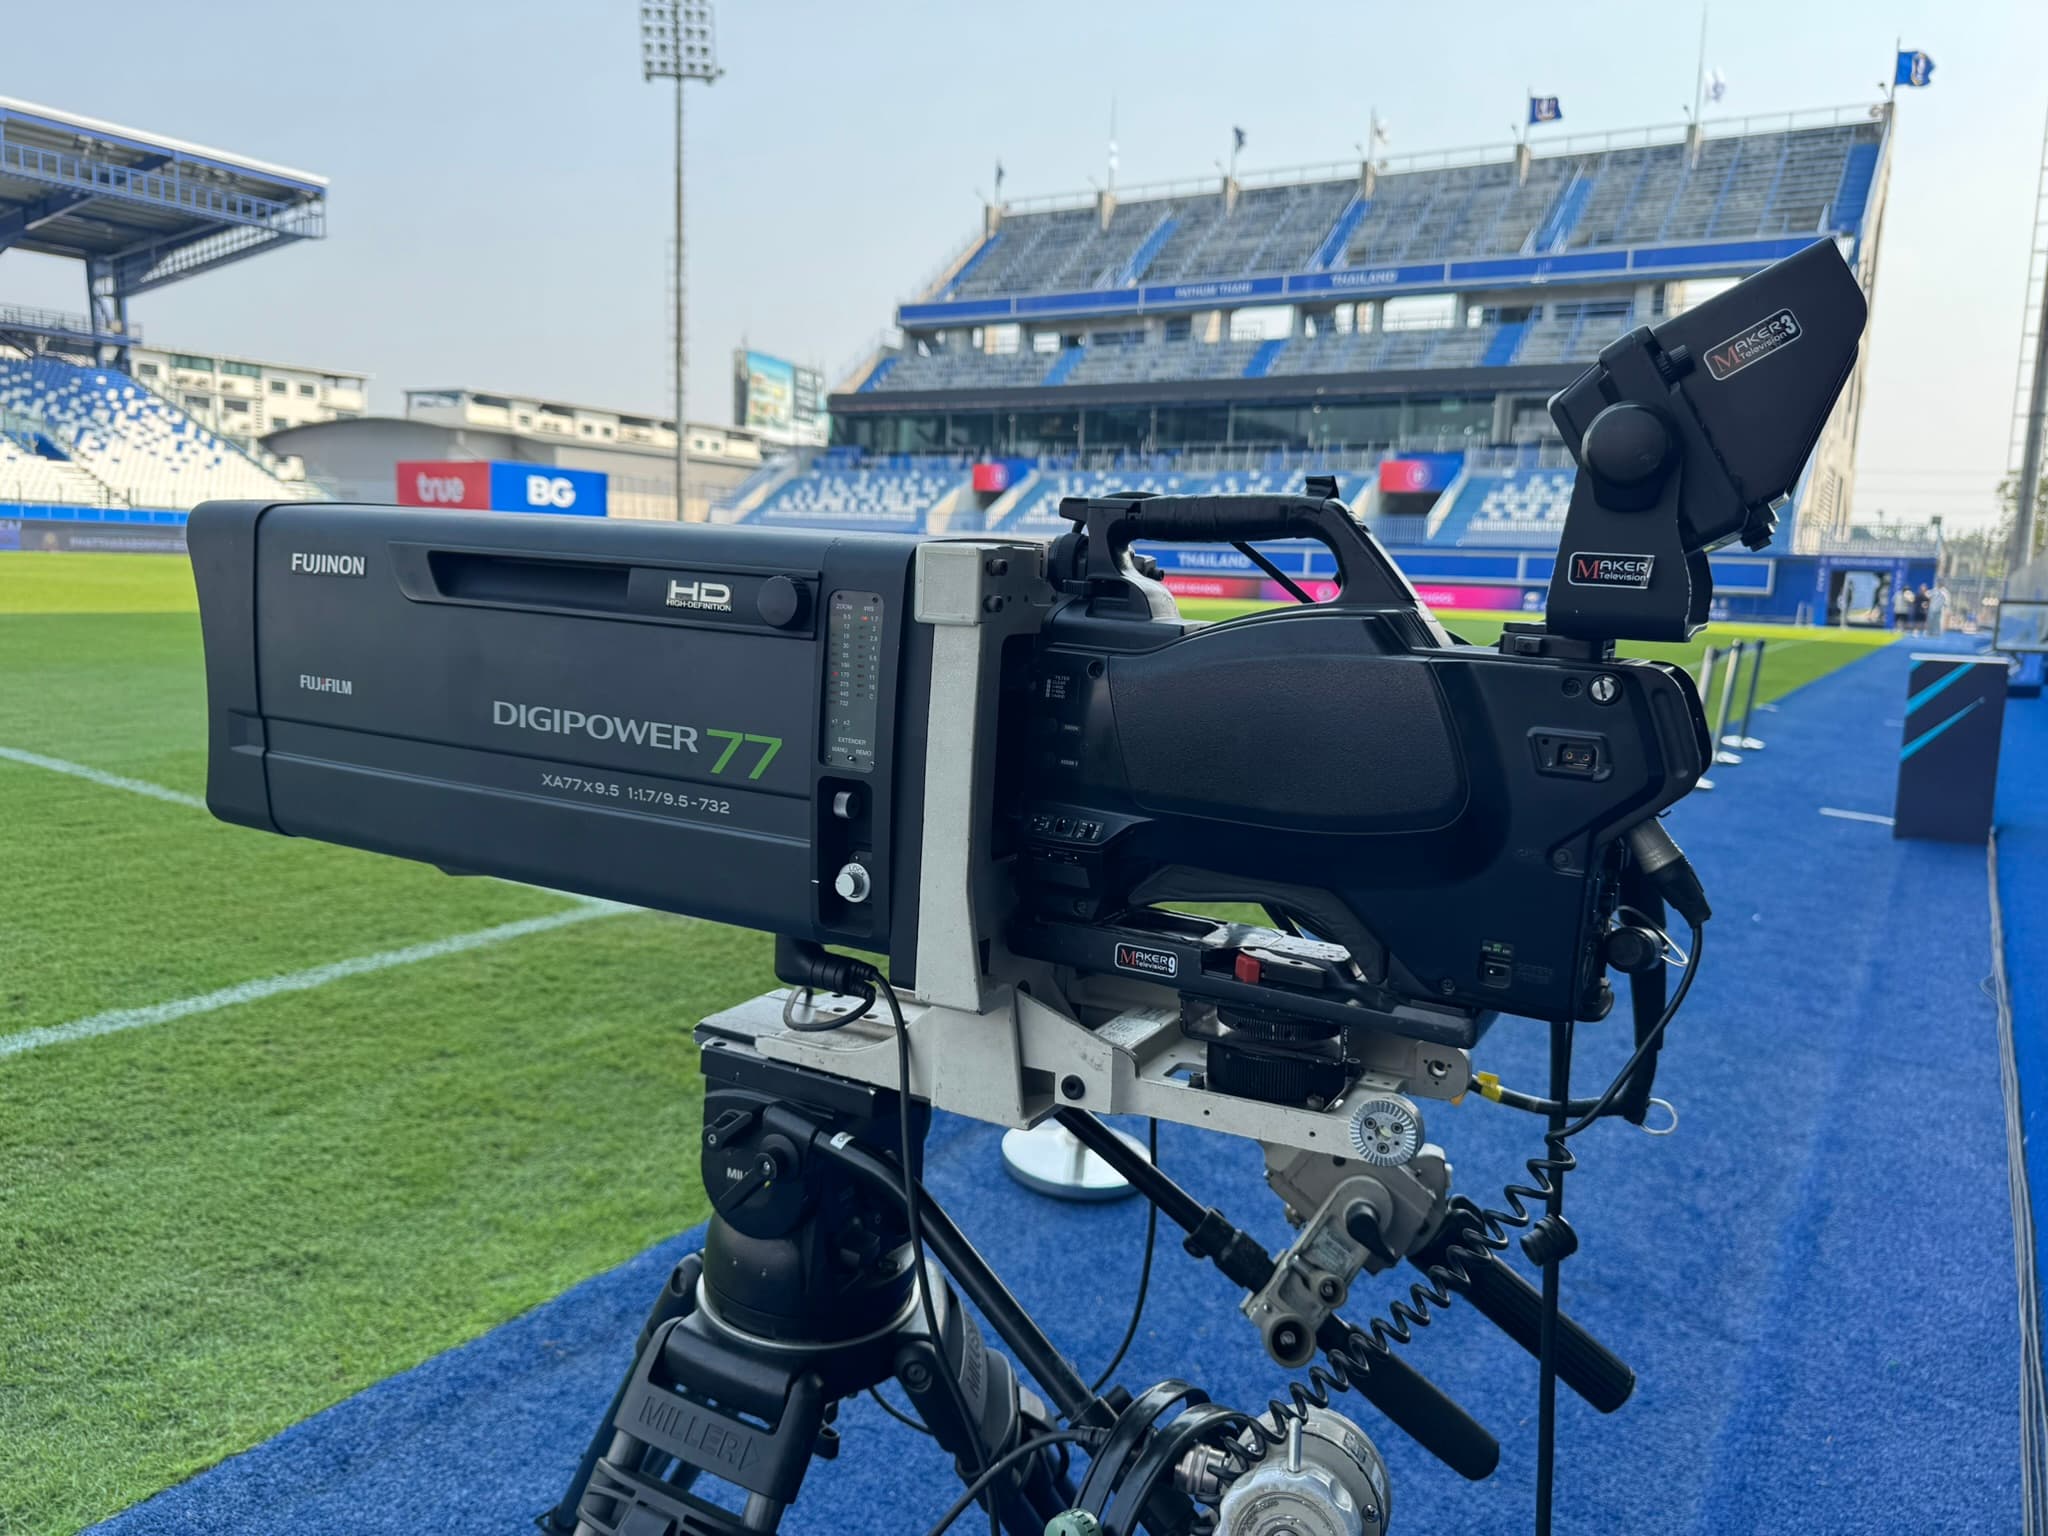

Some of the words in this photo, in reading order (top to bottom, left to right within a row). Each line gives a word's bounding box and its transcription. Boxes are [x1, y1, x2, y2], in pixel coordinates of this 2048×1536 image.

[1330, 270, 1399, 287] THAILAND
[1711, 320, 1782, 373] MAKER
[1739, 331, 1787, 360] Television
[416, 471, 465, 503] true
[526, 474, 576, 509] BG
[291, 552, 365, 576] FUJINON
[1177, 551, 1251, 569] THAILAND
[1575, 558, 1649, 581] MAKER
[1599, 571, 1648, 582] Television
[669, 579, 731, 604] HD
[665, 598, 732, 612] HIGH-DEFINITION
[300, 674, 353, 695] FUJIFILM
[492, 700, 699, 753] DIGIPOWER
[706, 728, 783, 780] 77
[1120, 948, 1168, 966] MAKER
[1136, 959, 1168, 971] Television
[638, 1395, 739, 1465] MILLER
